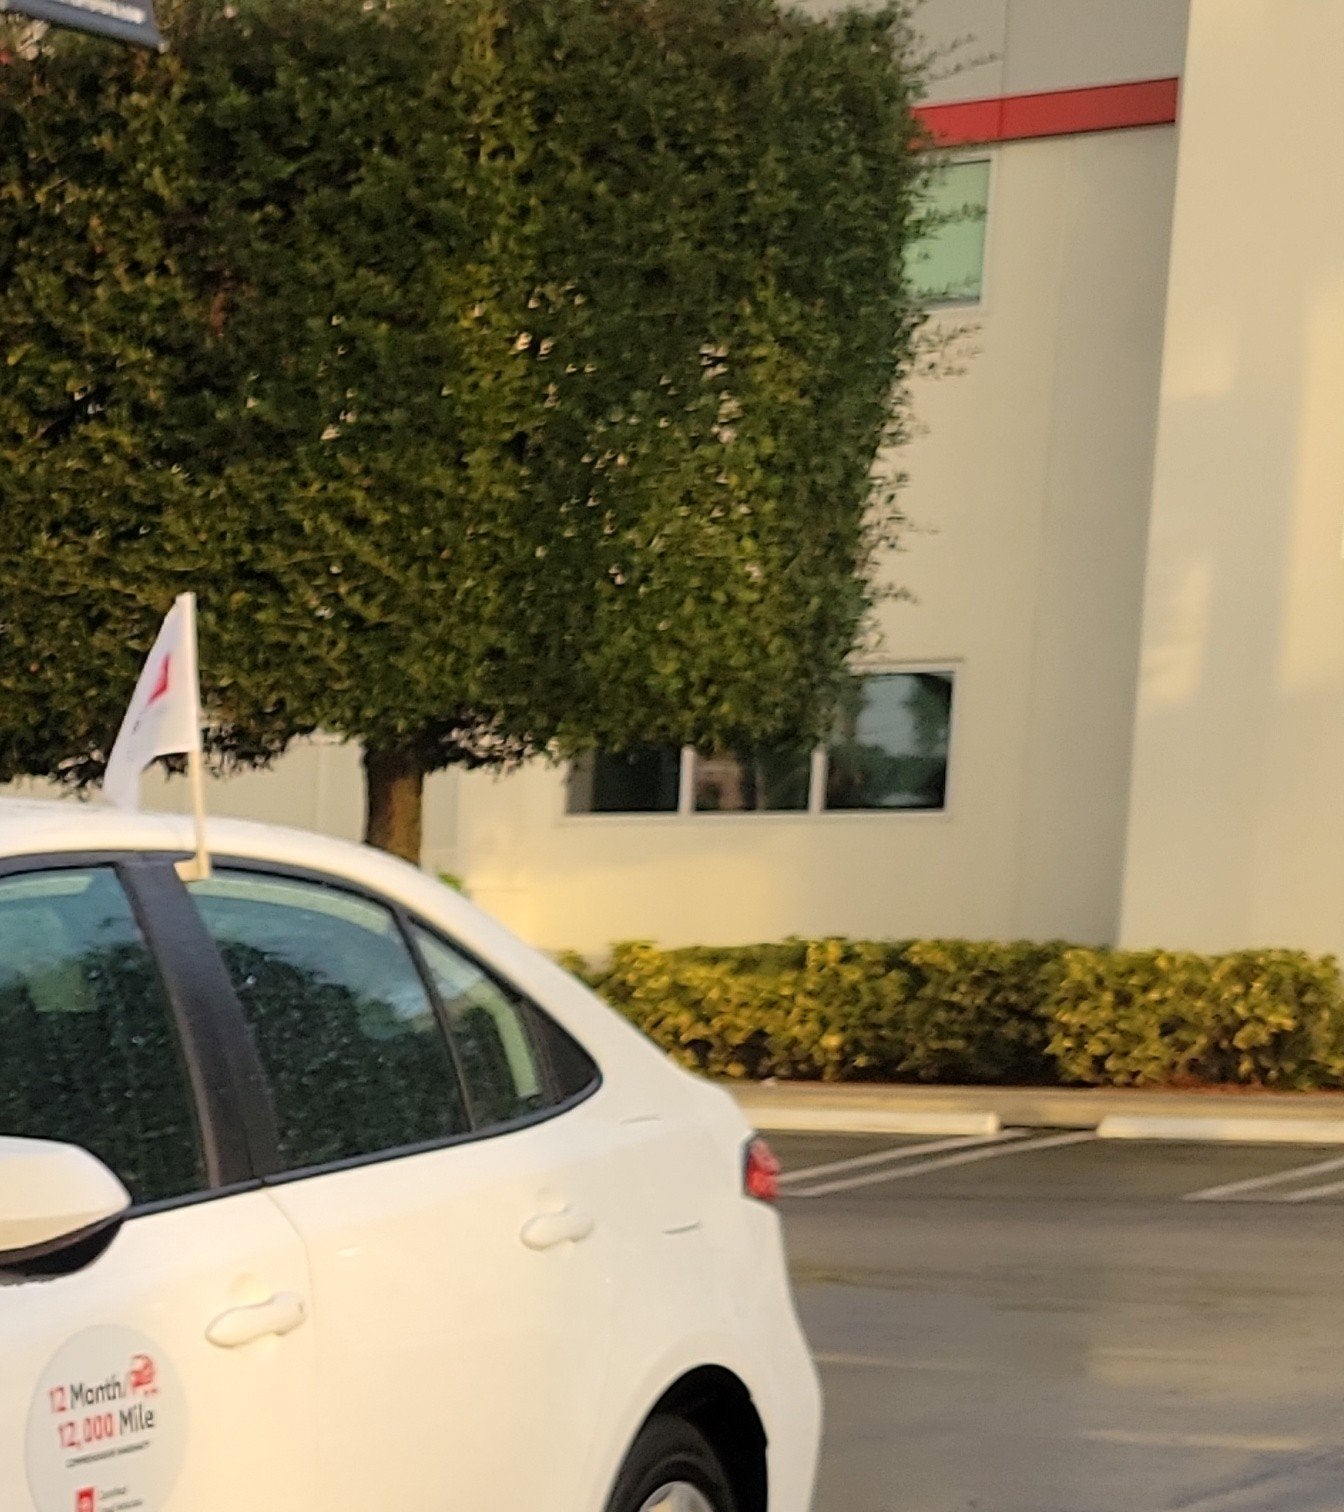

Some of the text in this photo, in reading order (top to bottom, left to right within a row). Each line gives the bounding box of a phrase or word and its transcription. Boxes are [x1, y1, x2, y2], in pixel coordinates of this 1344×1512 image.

[49, 1385, 67, 1412] 12
[58, 1403, 155, 1448] 12,000 Mile
